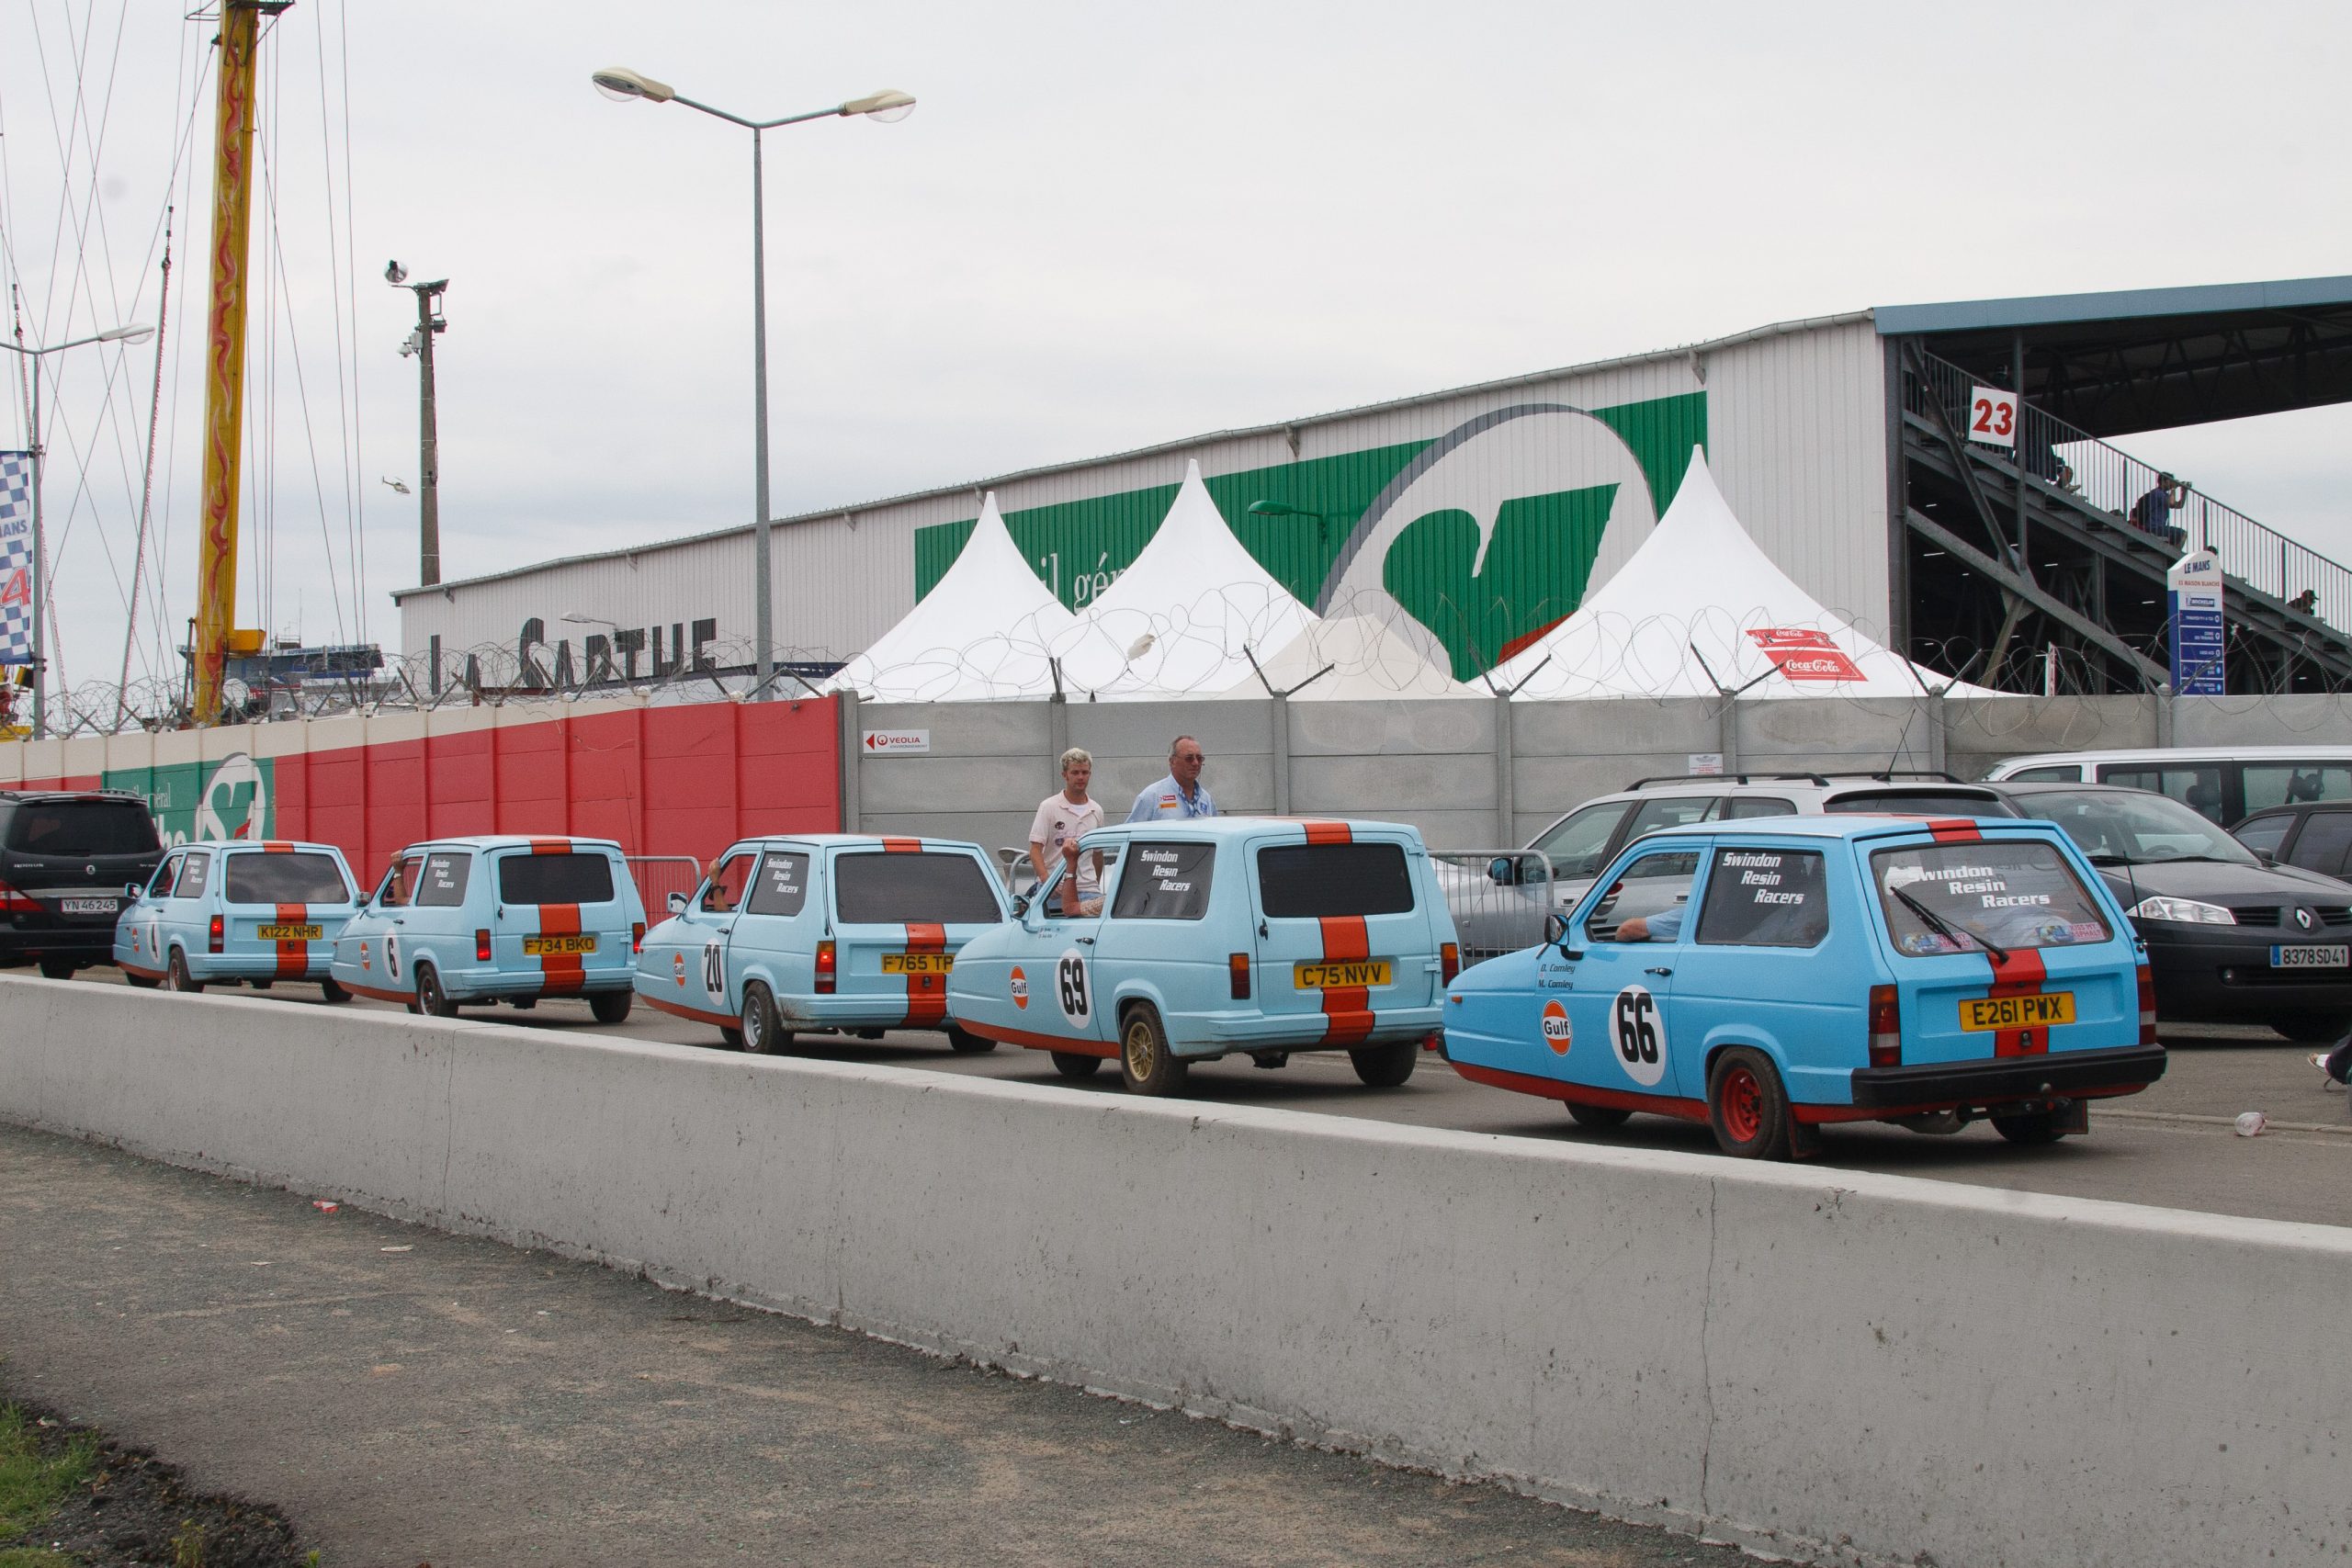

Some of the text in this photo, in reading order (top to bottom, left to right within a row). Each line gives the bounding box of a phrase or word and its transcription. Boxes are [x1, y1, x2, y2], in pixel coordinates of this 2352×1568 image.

[1973, 399, 2013, 436] 23
[2184, 559, 2211, 573] LE MANS
[1786, 659, 1840, 672] Coca-Cola
[767, 858, 793, 869] Swindon
[1141, 850, 1179, 863] Swindon
[1723, 852, 1781, 868] Swindon
[773, 871, 791, 881] Resin
[1152, 864, 1178, 876] Resin
[1159, 879, 1192, 891] Racers
[1740, 870, 1781, 886] Resin
[776, 883, 799, 894] Racers
[1949, 879, 2006, 895] Resin
[1754, 888, 1804, 905] Racers
[1982, 894, 2051, 908] Racers
[261, 926, 319, 938] K122 NHR
[151, 923, 158, 958] 1
[525, 937, 594, 953] F734 BKO
[387, 937, 398, 977] 6
[883, 956, 927, 971] F765
[704, 944, 723, 992] 20
[1303, 964, 1382, 986] C75 NVV
[1550, 964, 1576, 974] Comley
[1012, 981, 1028, 994] Gulf
[1059, 958, 1088, 1015] 69
[1538, 979, 1574, 990] M. Comley
[1973, 997, 2063, 1025] E261 PWX
[1544, 1021, 1569, 1035] Gulf
[1617, 992, 1659, 1064] 66
